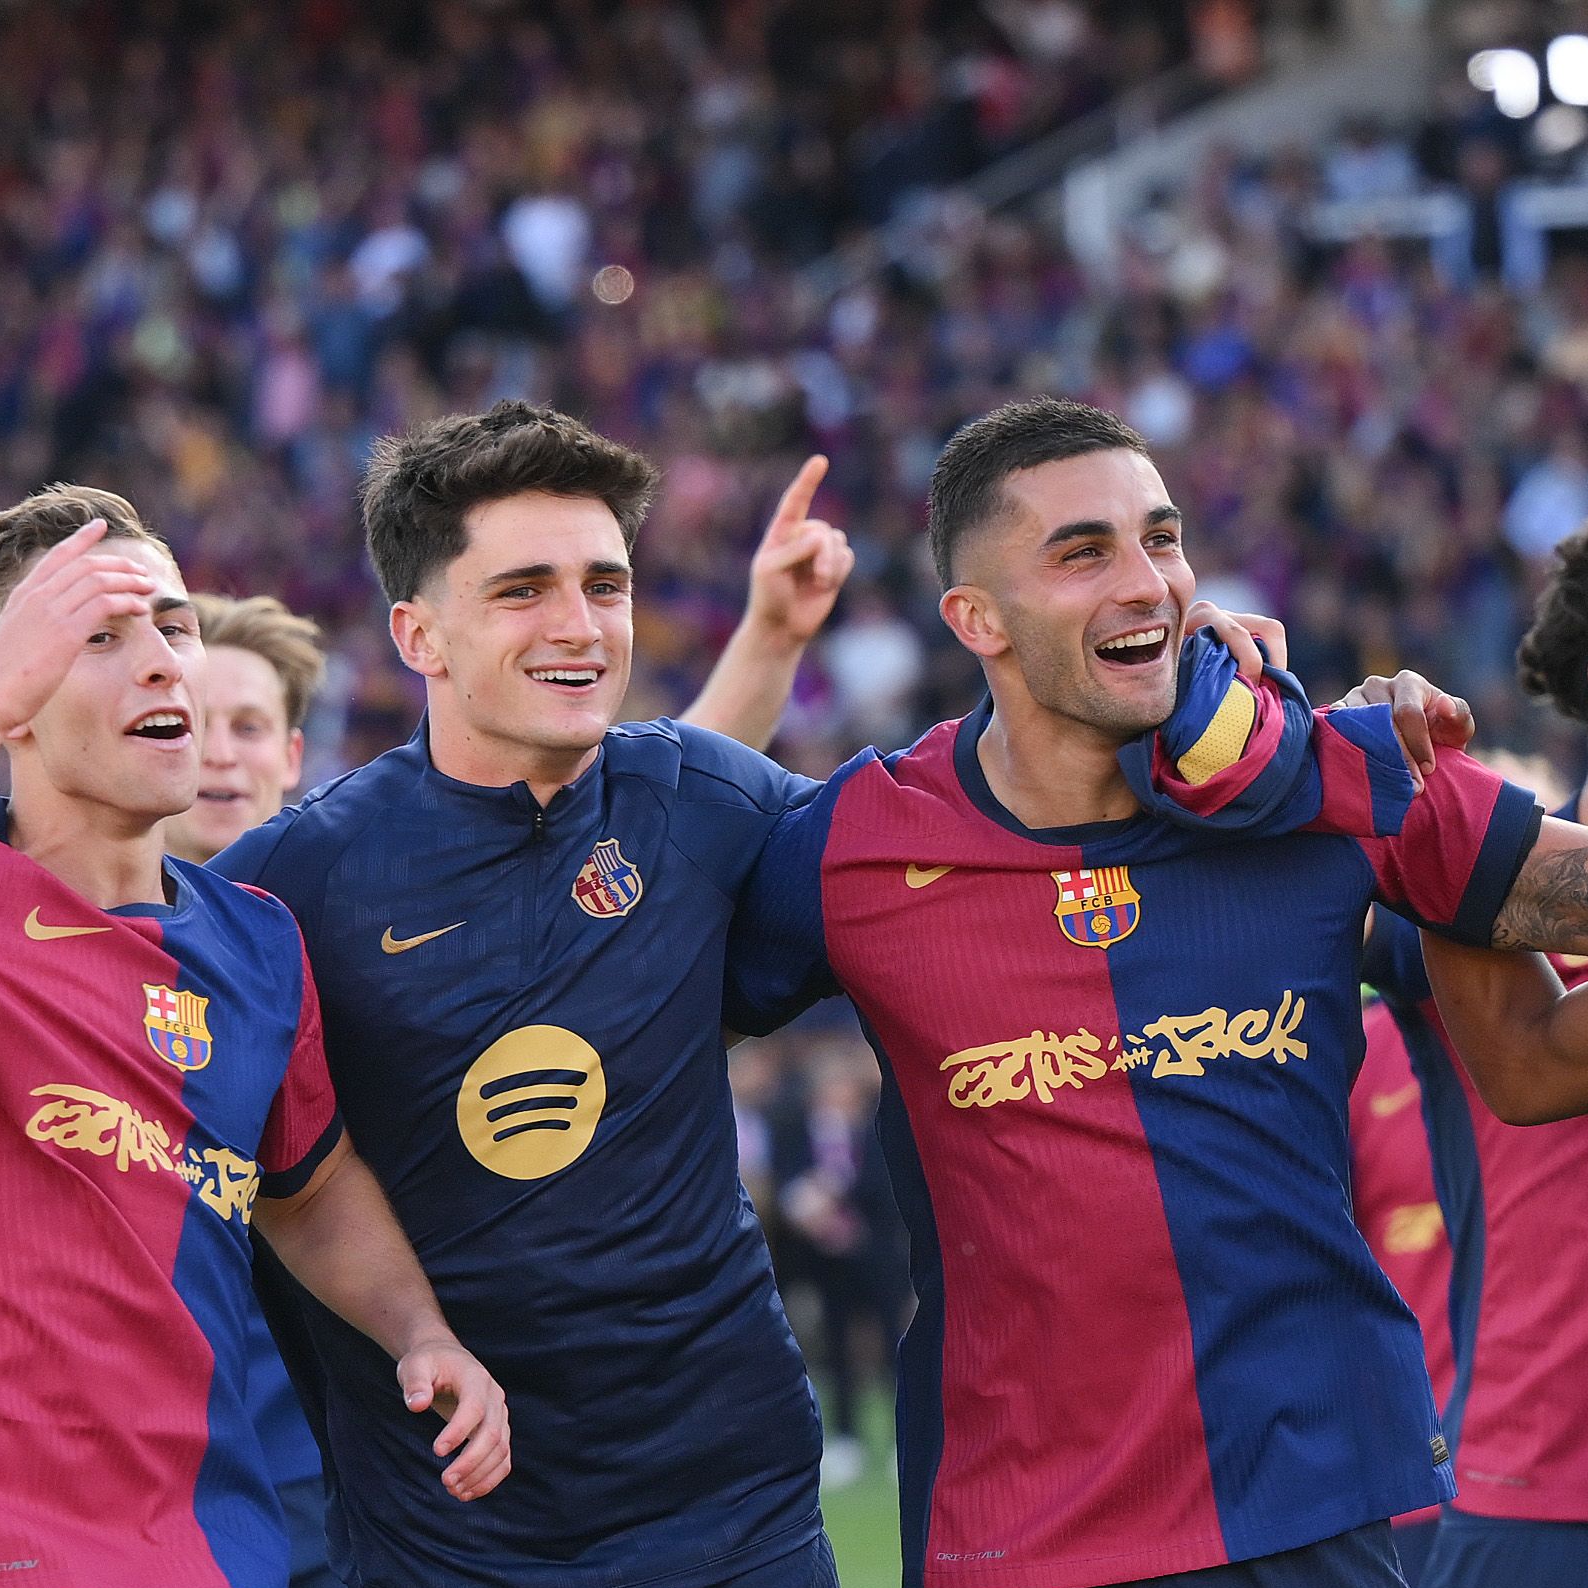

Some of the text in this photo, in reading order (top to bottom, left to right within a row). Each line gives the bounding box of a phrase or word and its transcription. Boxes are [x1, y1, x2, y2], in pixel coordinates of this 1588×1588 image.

[591, 873, 615, 890] FCB
[1080, 895, 1113, 910] FCB
[164, 1020, 191, 1035] FCB
